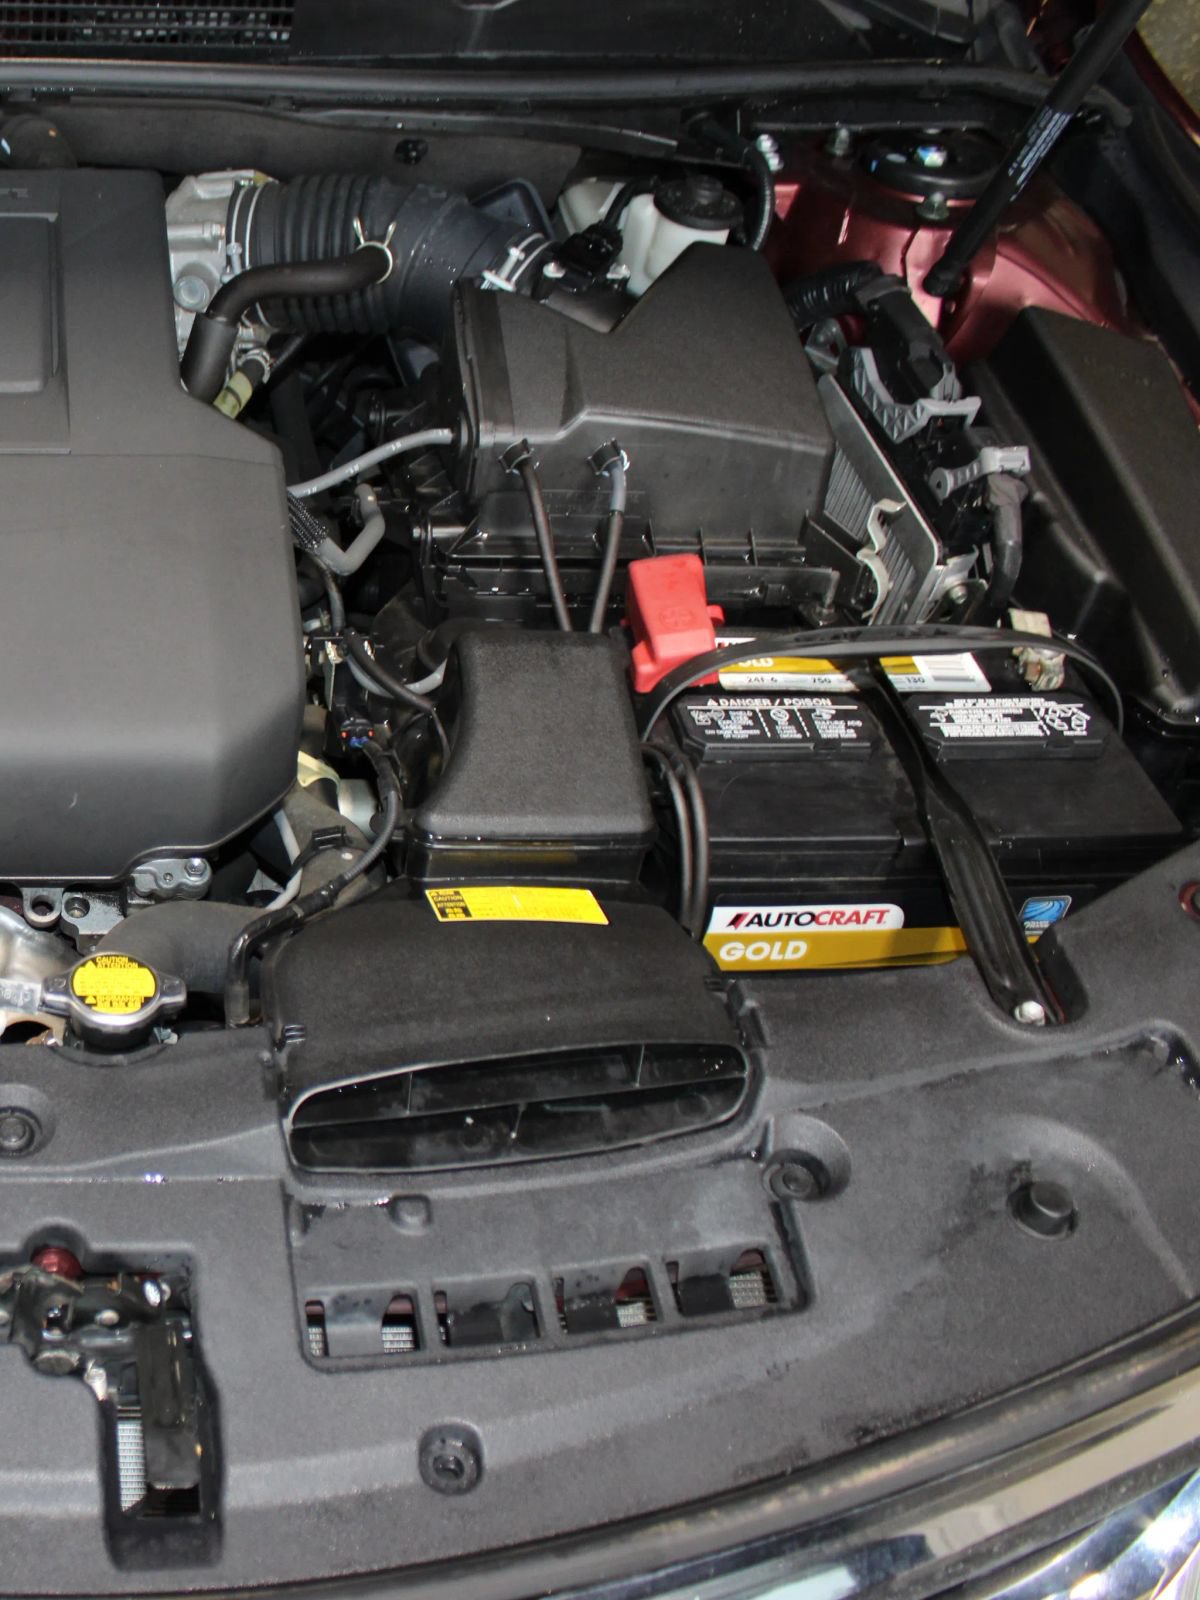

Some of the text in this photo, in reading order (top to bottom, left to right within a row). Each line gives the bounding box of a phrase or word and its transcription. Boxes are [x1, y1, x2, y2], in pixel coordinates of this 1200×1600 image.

[718, 697, 772, 707] DANGER
[783, 697, 833, 707] POISON
[745, 908, 891, 928] AUTOCRAFT
[719, 940, 809, 962] GOLD
